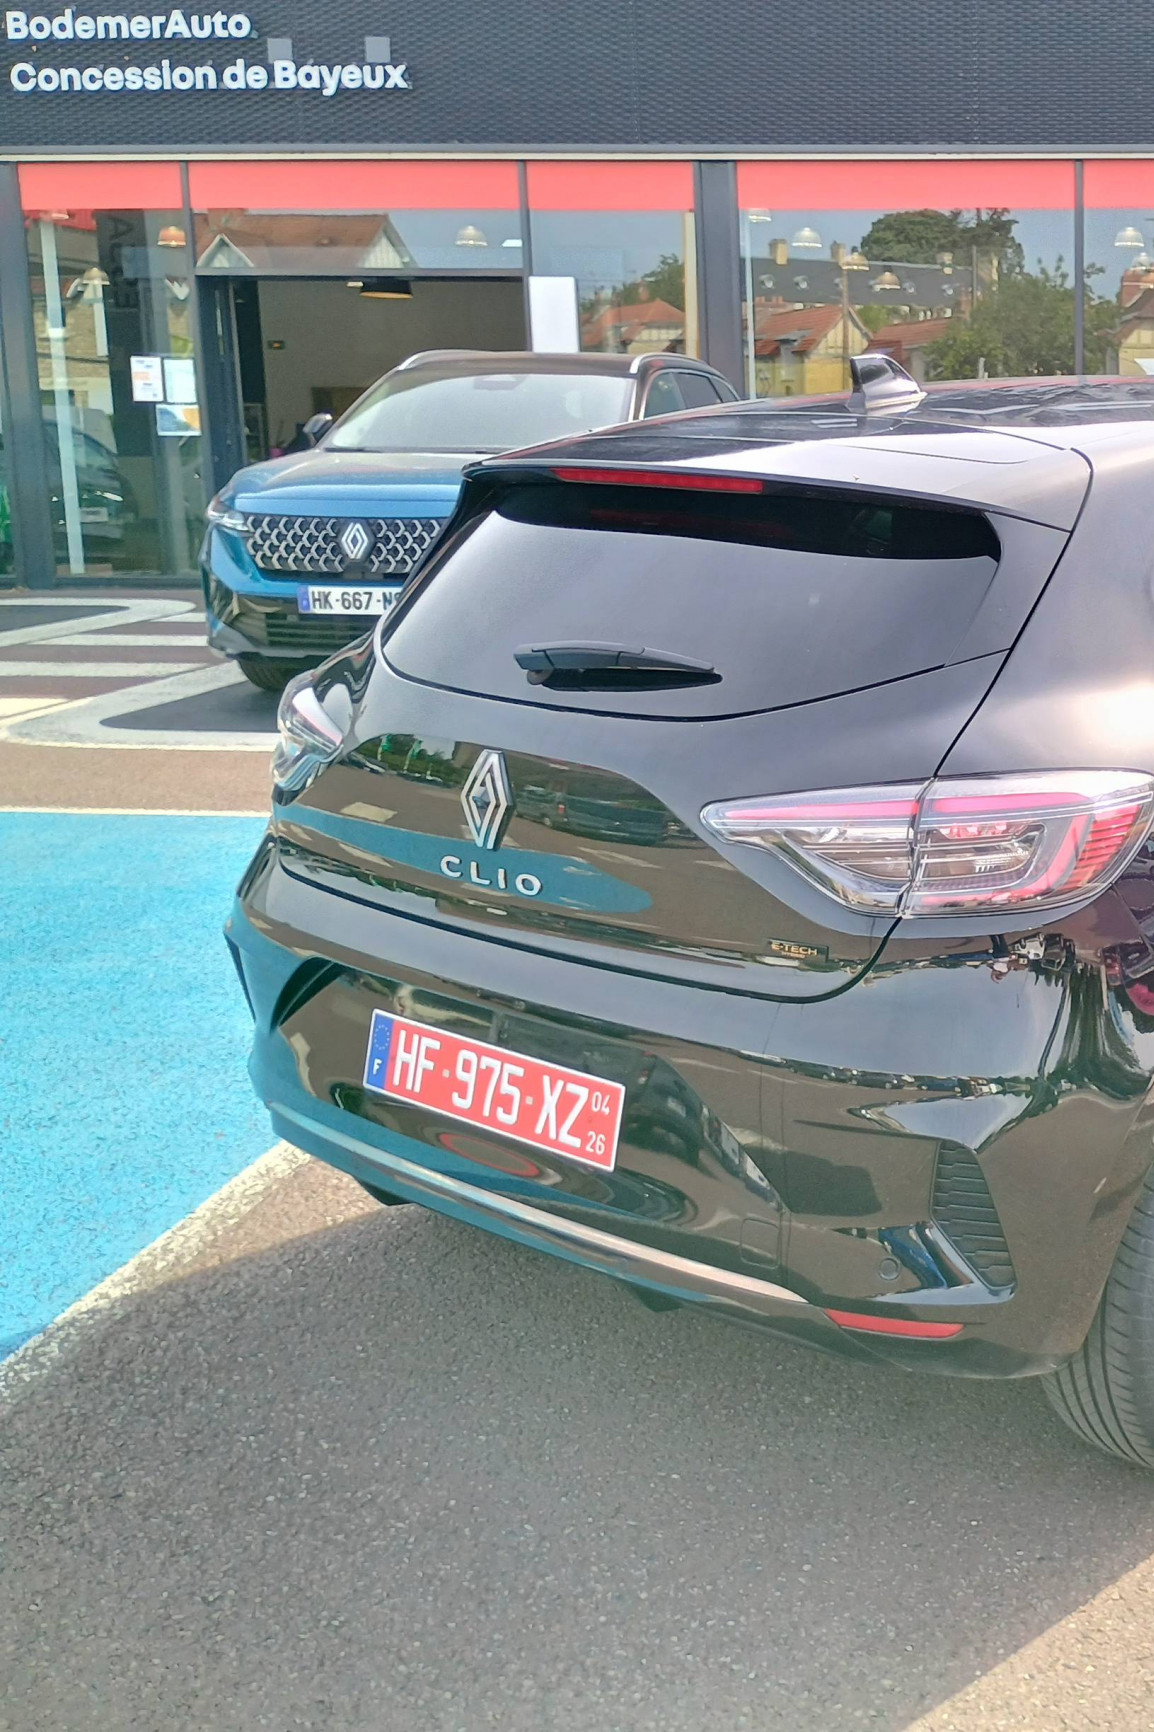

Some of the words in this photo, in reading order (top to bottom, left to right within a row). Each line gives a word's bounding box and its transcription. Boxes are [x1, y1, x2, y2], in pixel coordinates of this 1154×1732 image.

[4, 8, 252, 40] BodemerAuto
[9, 58, 218, 92] Concession
[222, 58, 269, 90] de
[273, 59, 409, 97] Bayeux
[440, 855, 542, 896] CLIO
[771, 942, 818, 956] E-TECH
[372, 1058, 382, 1076] F
[591, 1090, 611, 1117] 04
[585, 1130, 606, 1156] 26
